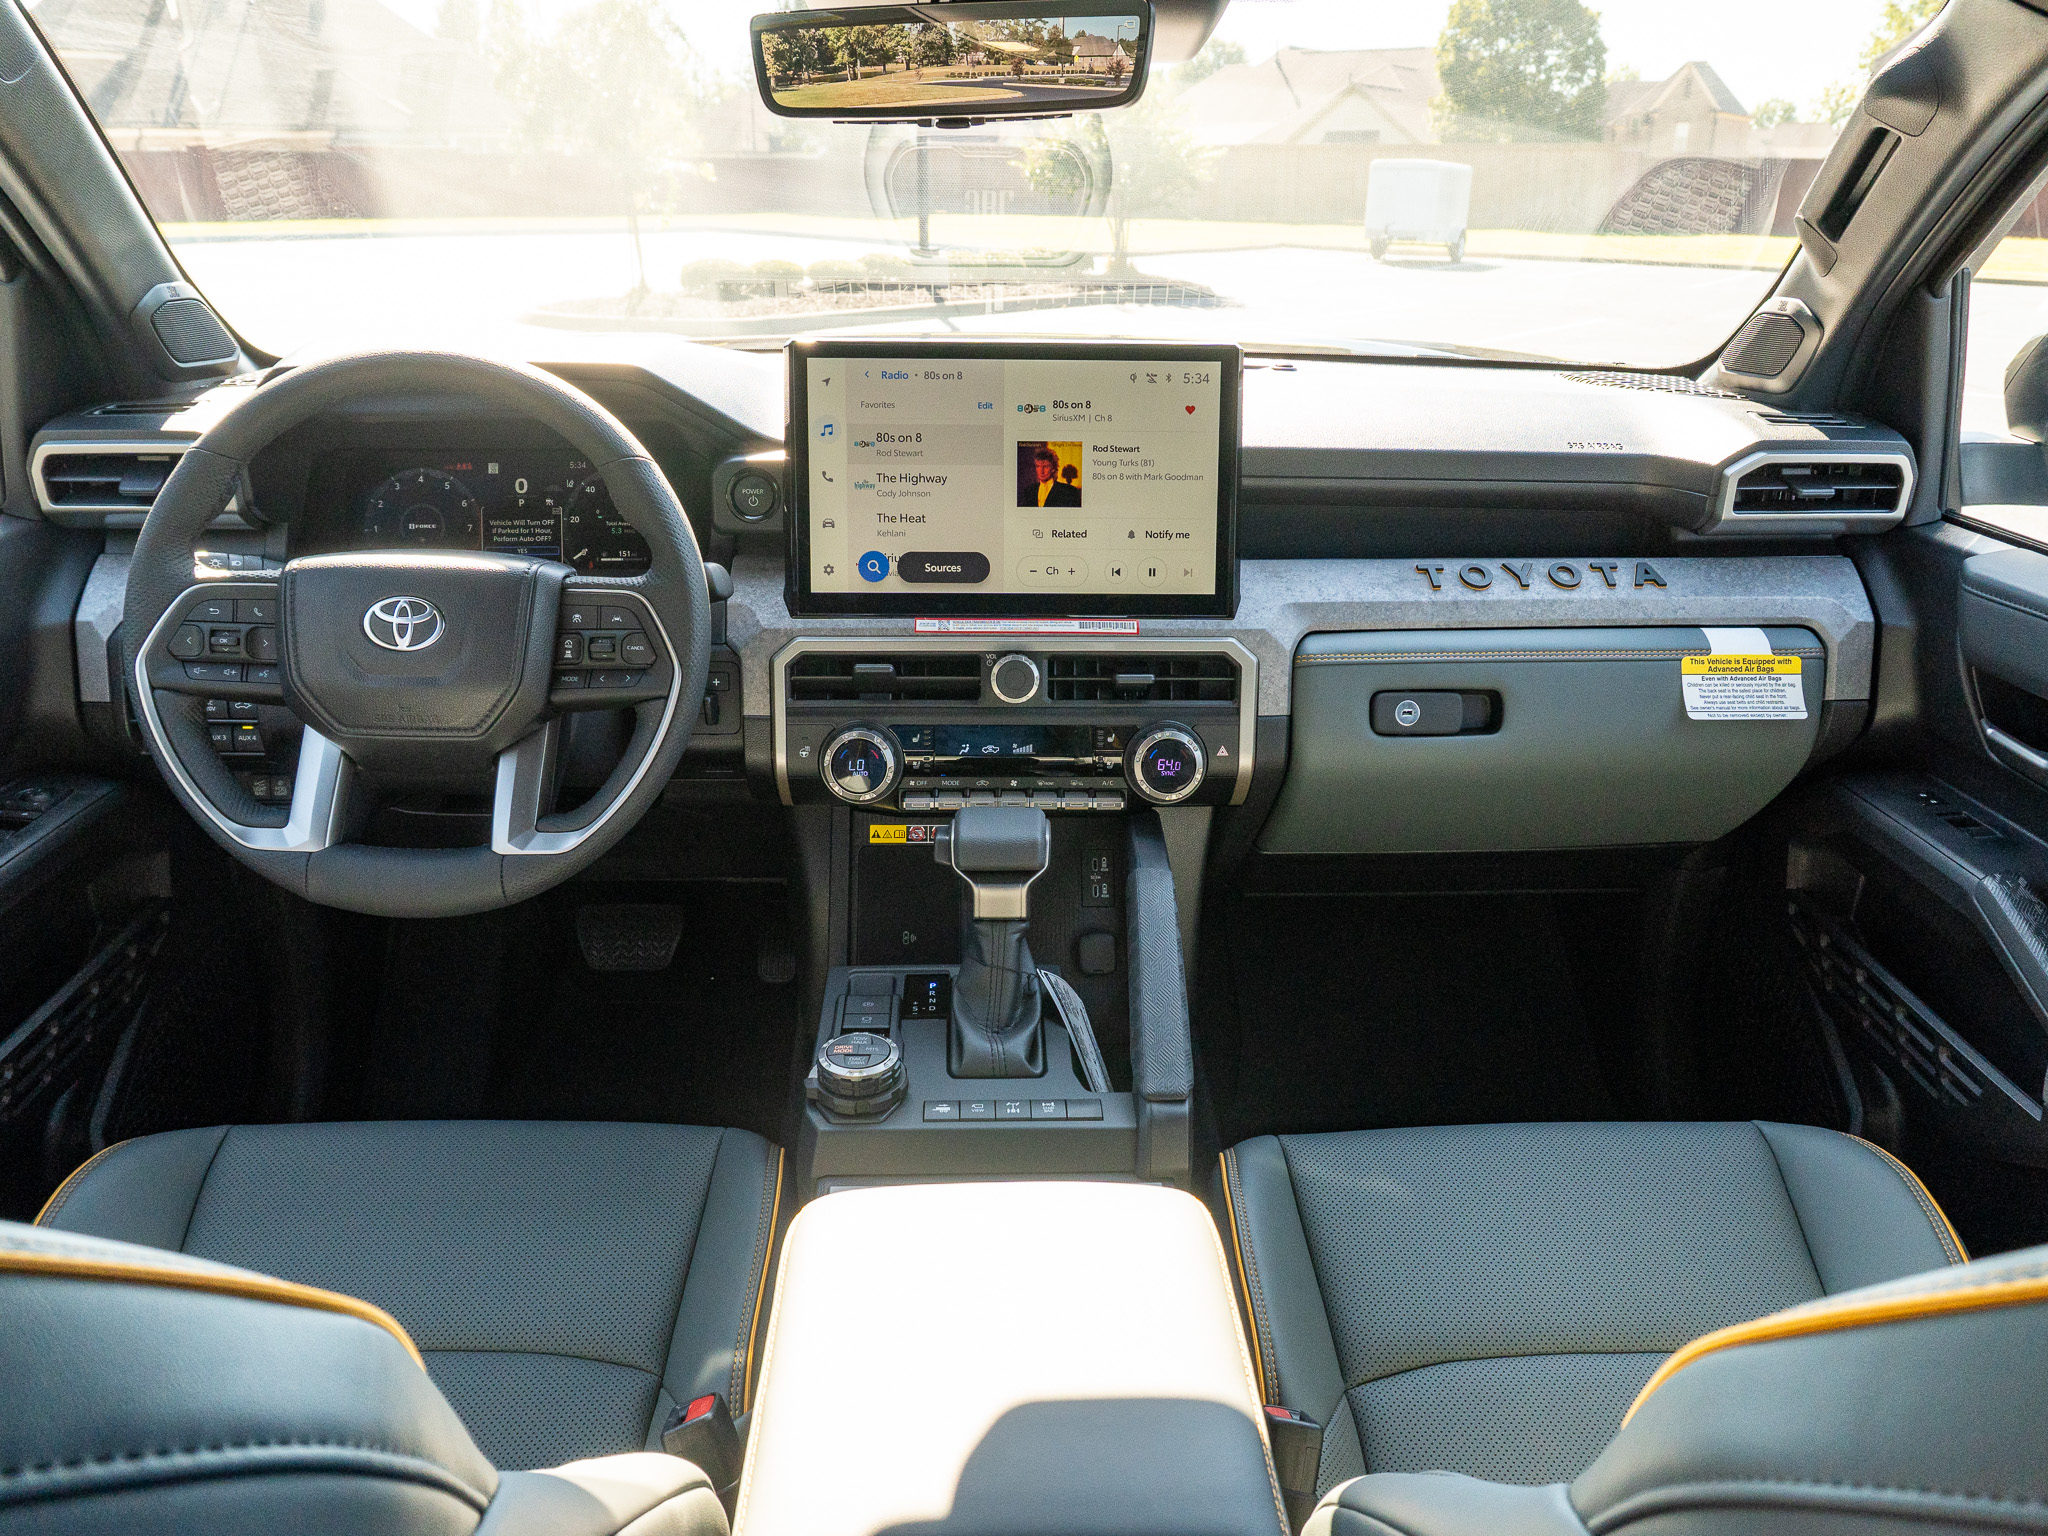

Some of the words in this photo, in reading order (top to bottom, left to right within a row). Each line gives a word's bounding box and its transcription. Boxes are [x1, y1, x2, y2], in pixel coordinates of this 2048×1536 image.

[881, 371, 909, 380] Radio
[924, 371, 940, 380] 80s
[957, 371, 963, 380] 8
[1183, 373, 1210, 384] 5:34
[860, 401, 895, 409] Favorites
[977, 402, 993, 410] Edit
[1052, 400, 1069, 409] 80s
[1085, 400, 1091, 409] 8
[1052, 414, 1086, 422] SiriusXM
[1094, 414, 1106, 422] Ch
[1107, 414, 1113, 422] 8
[876, 433, 895, 443] 80s
[898, 435, 912, 443] on
[915, 433, 922, 443] 8
[876, 449, 892, 457] Rod
[893, 449, 923, 457] Stewart
[1092, 445, 1108, 453] Rod
[1109, 445, 1140, 453] Stewart
[1092, 459, 1118, 468] Young
[1119, 459, 1139, 467] Turks
[1140, 458, 1155, 468] (81)
[876, 473, 897, 483] The
[899, 473, 948, 485] Highway
[1092, 473, 1105, 481] 80s
[1119, 473, 1124, 481] 8
[1125, 473, 1142, 481] with
[1143, 473, 1163, 481] Mark
[1164, 473, 1204, 481] Goodman
[515, 478, 527, 493] 0
[876, 490, 897, 499] Cody
[898, 490, 931, 498] Johnson
[377, 500, 383, 508] 2
[518, 499, 525, 507] P
[876, 513, 897, 523] The
[900, 513, 926, 523] Heat
[467, 524, 473, 532] 7
[876, 529, 906, 538] Kehlani
[1051, 530, 1087, 538] Related
[1145, 530, 1174, 540] Notify
[924, 563, 961, 572] Sources
[1045, 566, 1059, 575] Ch
[1415, 561, 1668, 591] TOYOTA
[1689, 657, 1705, 665] This
[1706, 657, 1732, 665] Vehicle
[1742, 657, 1775, 666] Equipped
[1707, 665, 1743, 673] Advanced
[1756, 665, 1775, 674] Bags
[848, 759, 865, 771] LO
[1157, 758, 1181, 771] 64.0
